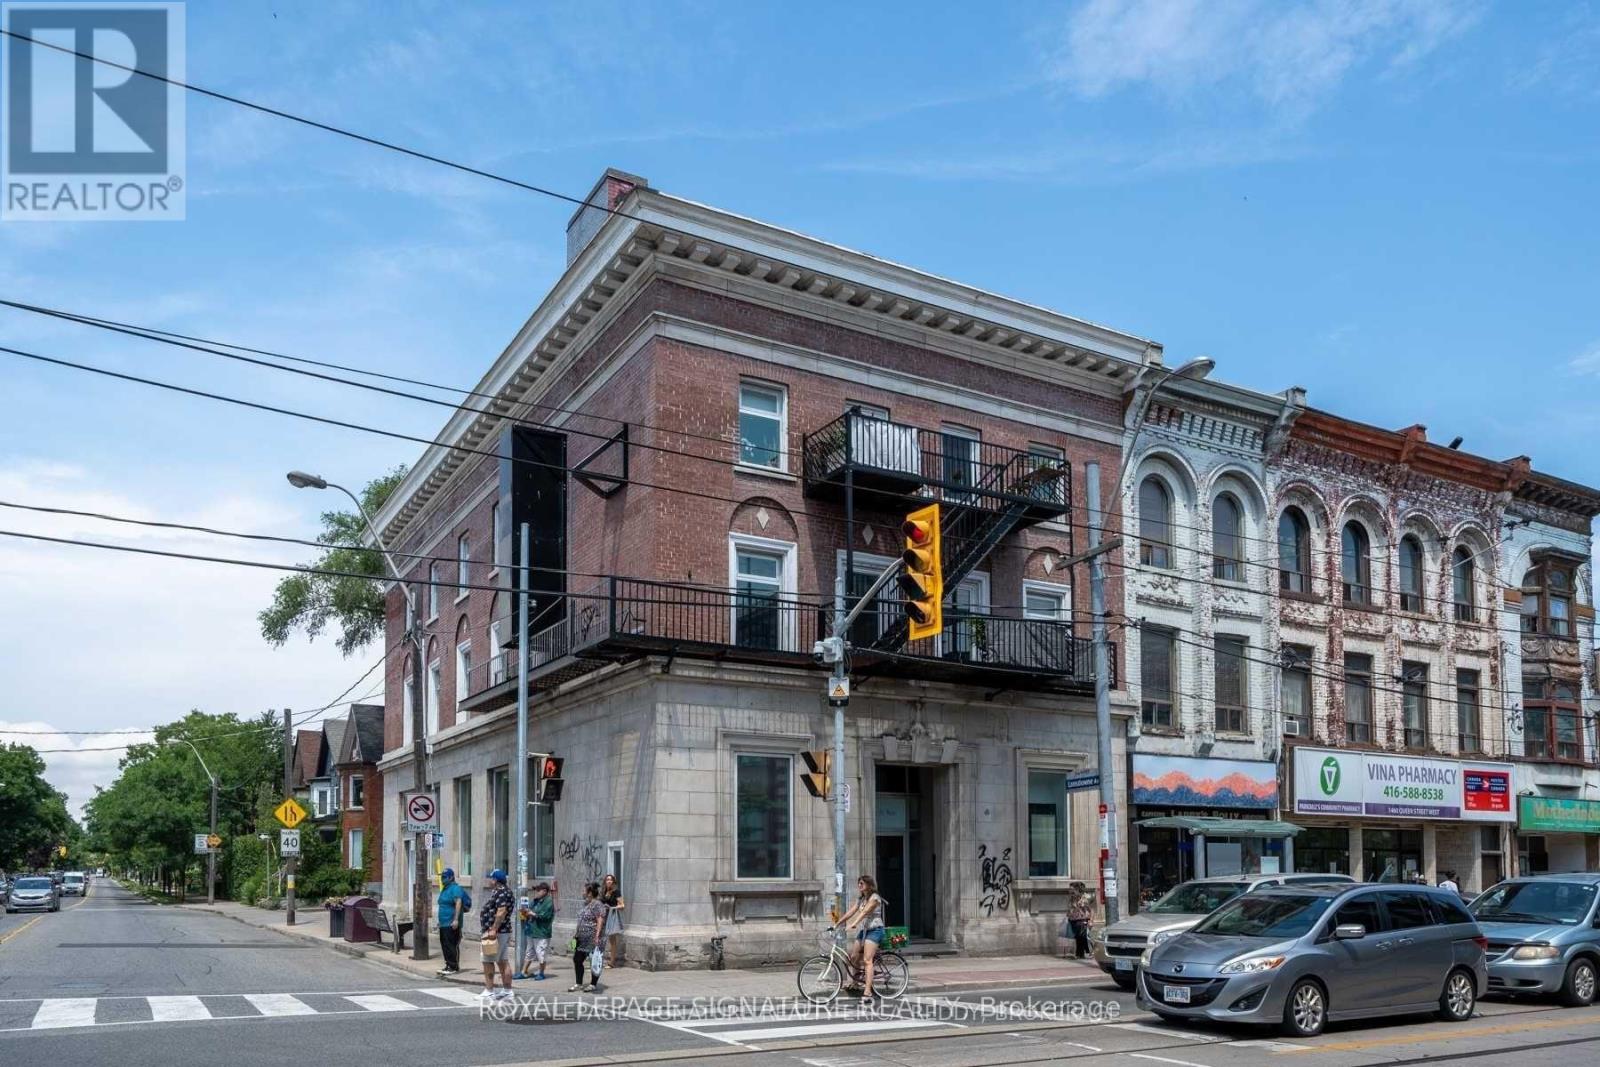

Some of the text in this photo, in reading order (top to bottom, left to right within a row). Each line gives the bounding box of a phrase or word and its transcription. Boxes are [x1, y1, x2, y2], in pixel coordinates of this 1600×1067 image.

[1368, 763, 1457, 785] VINA PHARMACY
[283, 837, 298, 848] 40
